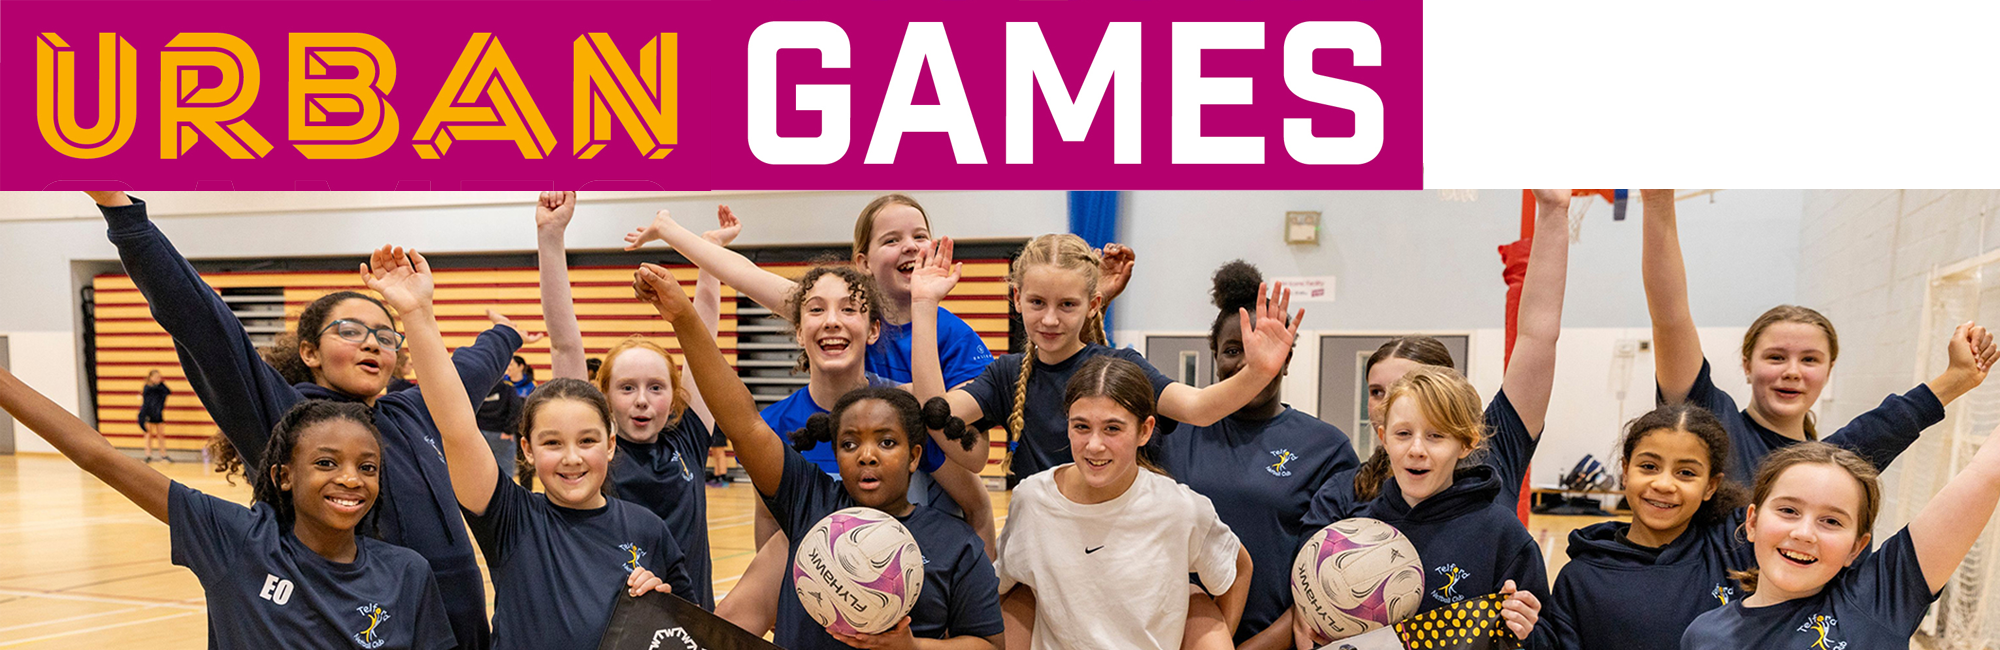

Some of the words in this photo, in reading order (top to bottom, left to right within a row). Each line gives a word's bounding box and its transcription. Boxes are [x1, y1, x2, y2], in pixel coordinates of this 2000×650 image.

[1434, 562, 1471, 580] Telford
[259, 573, 295, 606] EO
[356, 602, 391, 622] Telford
[1796, 613, 1837, 632] Telford
